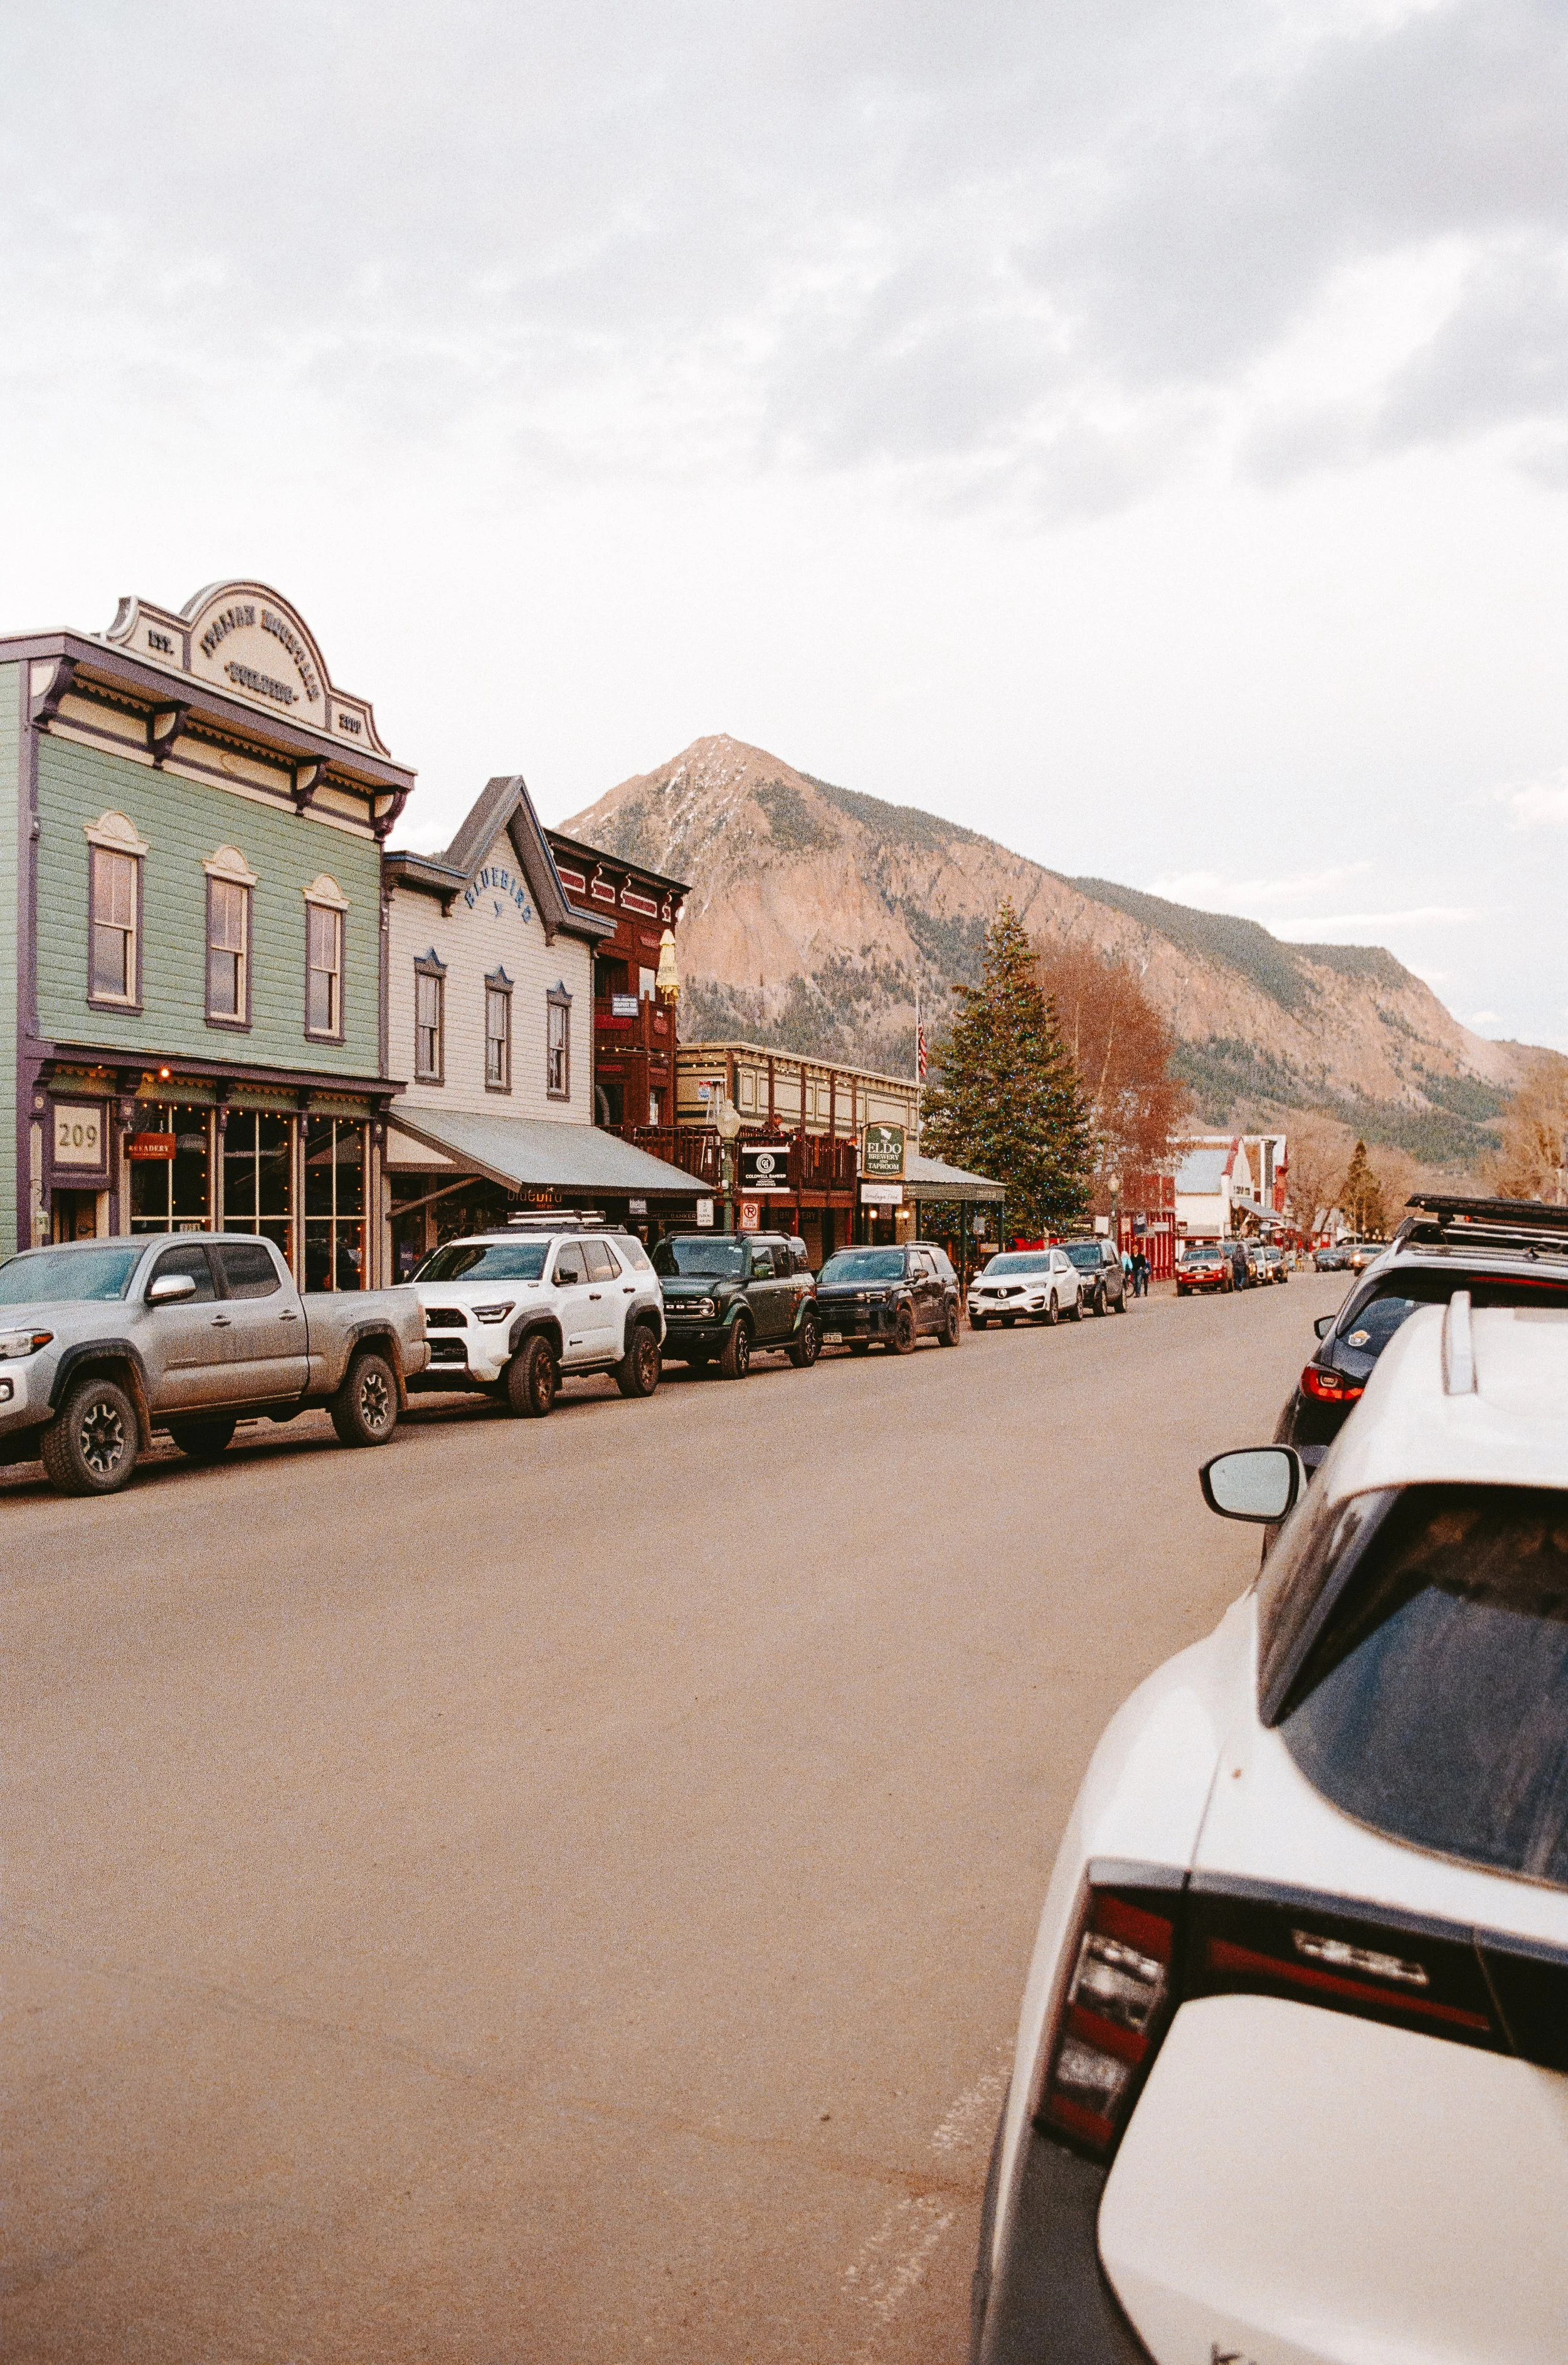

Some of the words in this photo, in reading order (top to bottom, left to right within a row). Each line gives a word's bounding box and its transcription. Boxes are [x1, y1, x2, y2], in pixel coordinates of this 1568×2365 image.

[464, 866, 532, 924] BLUEBIRD
[59, 1123, 98, 1149] 209
[867, 1142, 902, 1154] ELDO
[779, 1211, 816, 1220] BRERY
